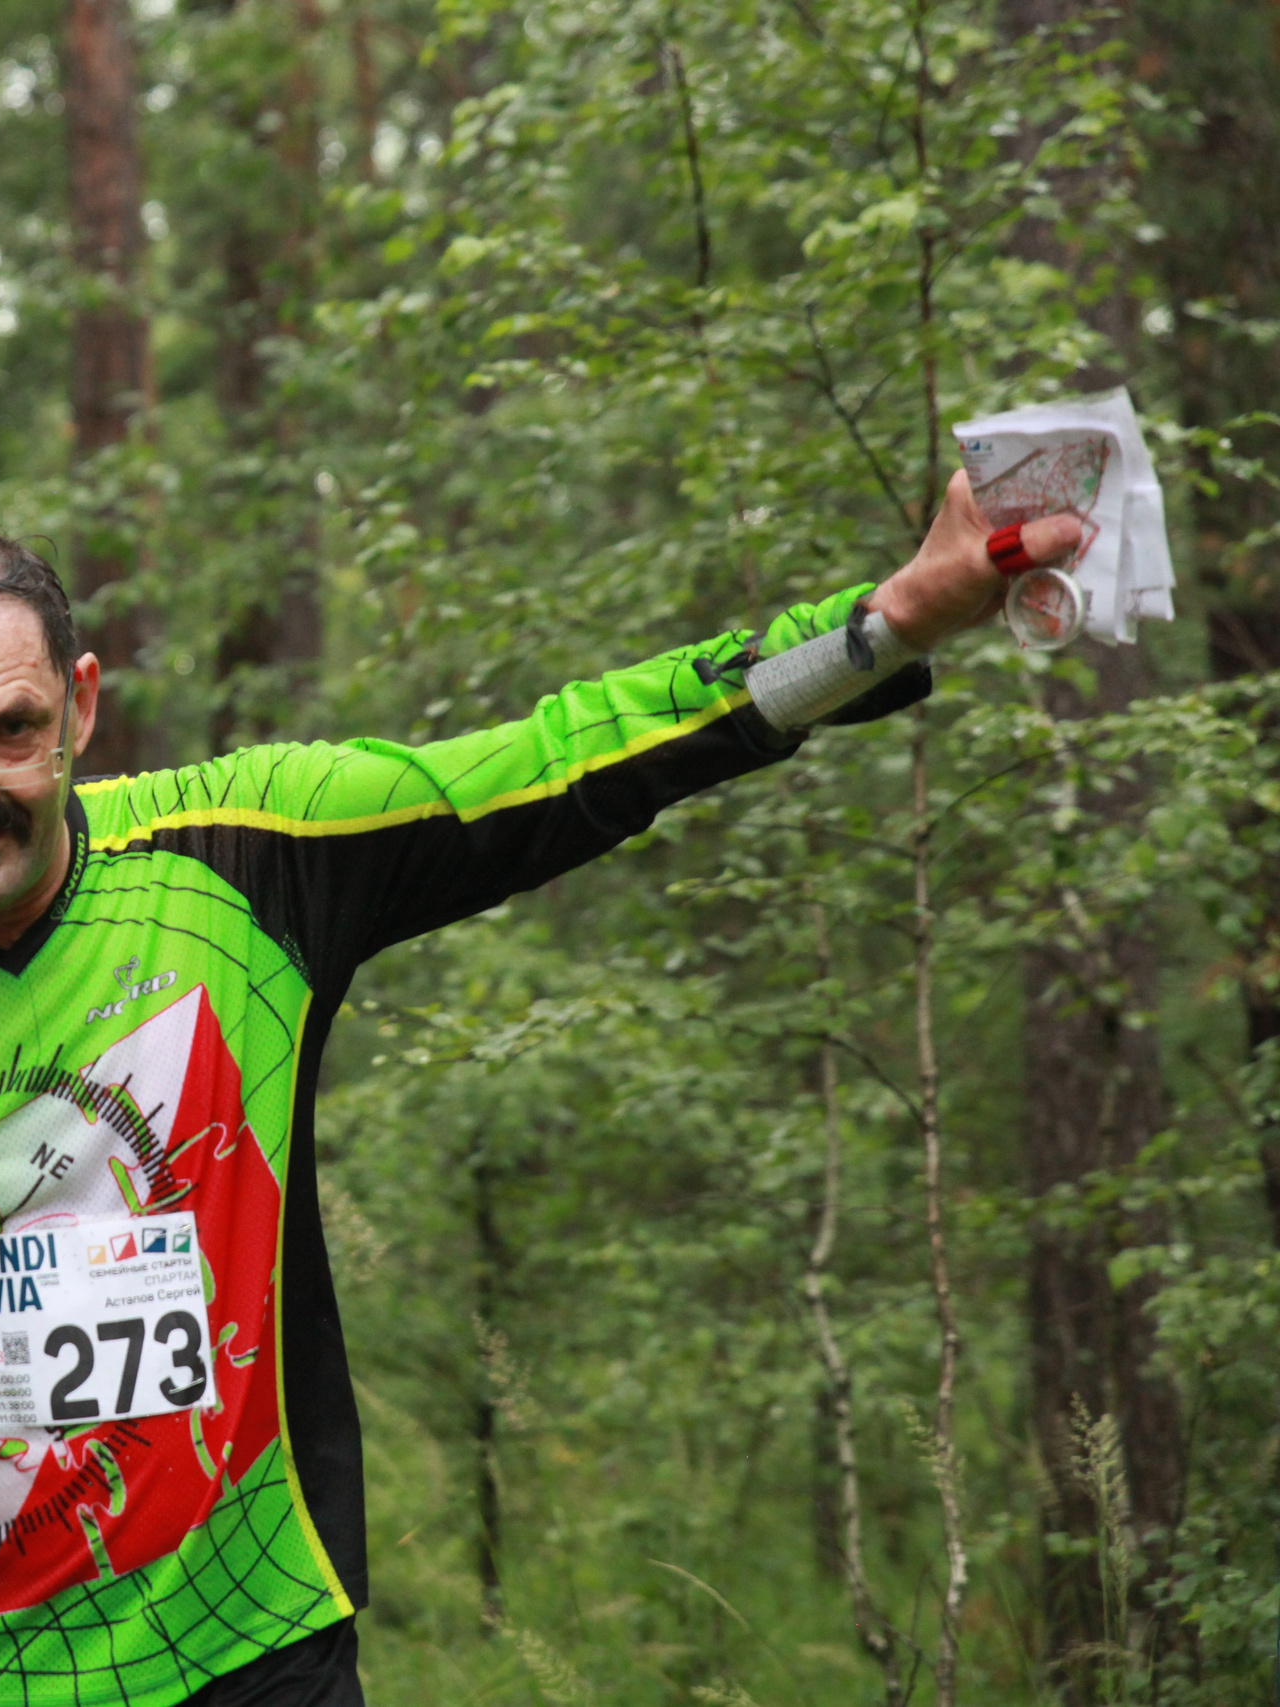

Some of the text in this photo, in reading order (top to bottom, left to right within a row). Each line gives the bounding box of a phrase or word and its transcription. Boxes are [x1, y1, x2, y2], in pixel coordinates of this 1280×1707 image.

[30, 1141, 74, 1180] NE
[89, 1257, 192, 1278] СЕМЕЙНЫЕ СТАРТЫ
[144, 1269, 200, 1286] СПАРТАК
[105, 1284, 201, 1308] Астапов Сергей
[43, 1310, 208, 1421] 273
